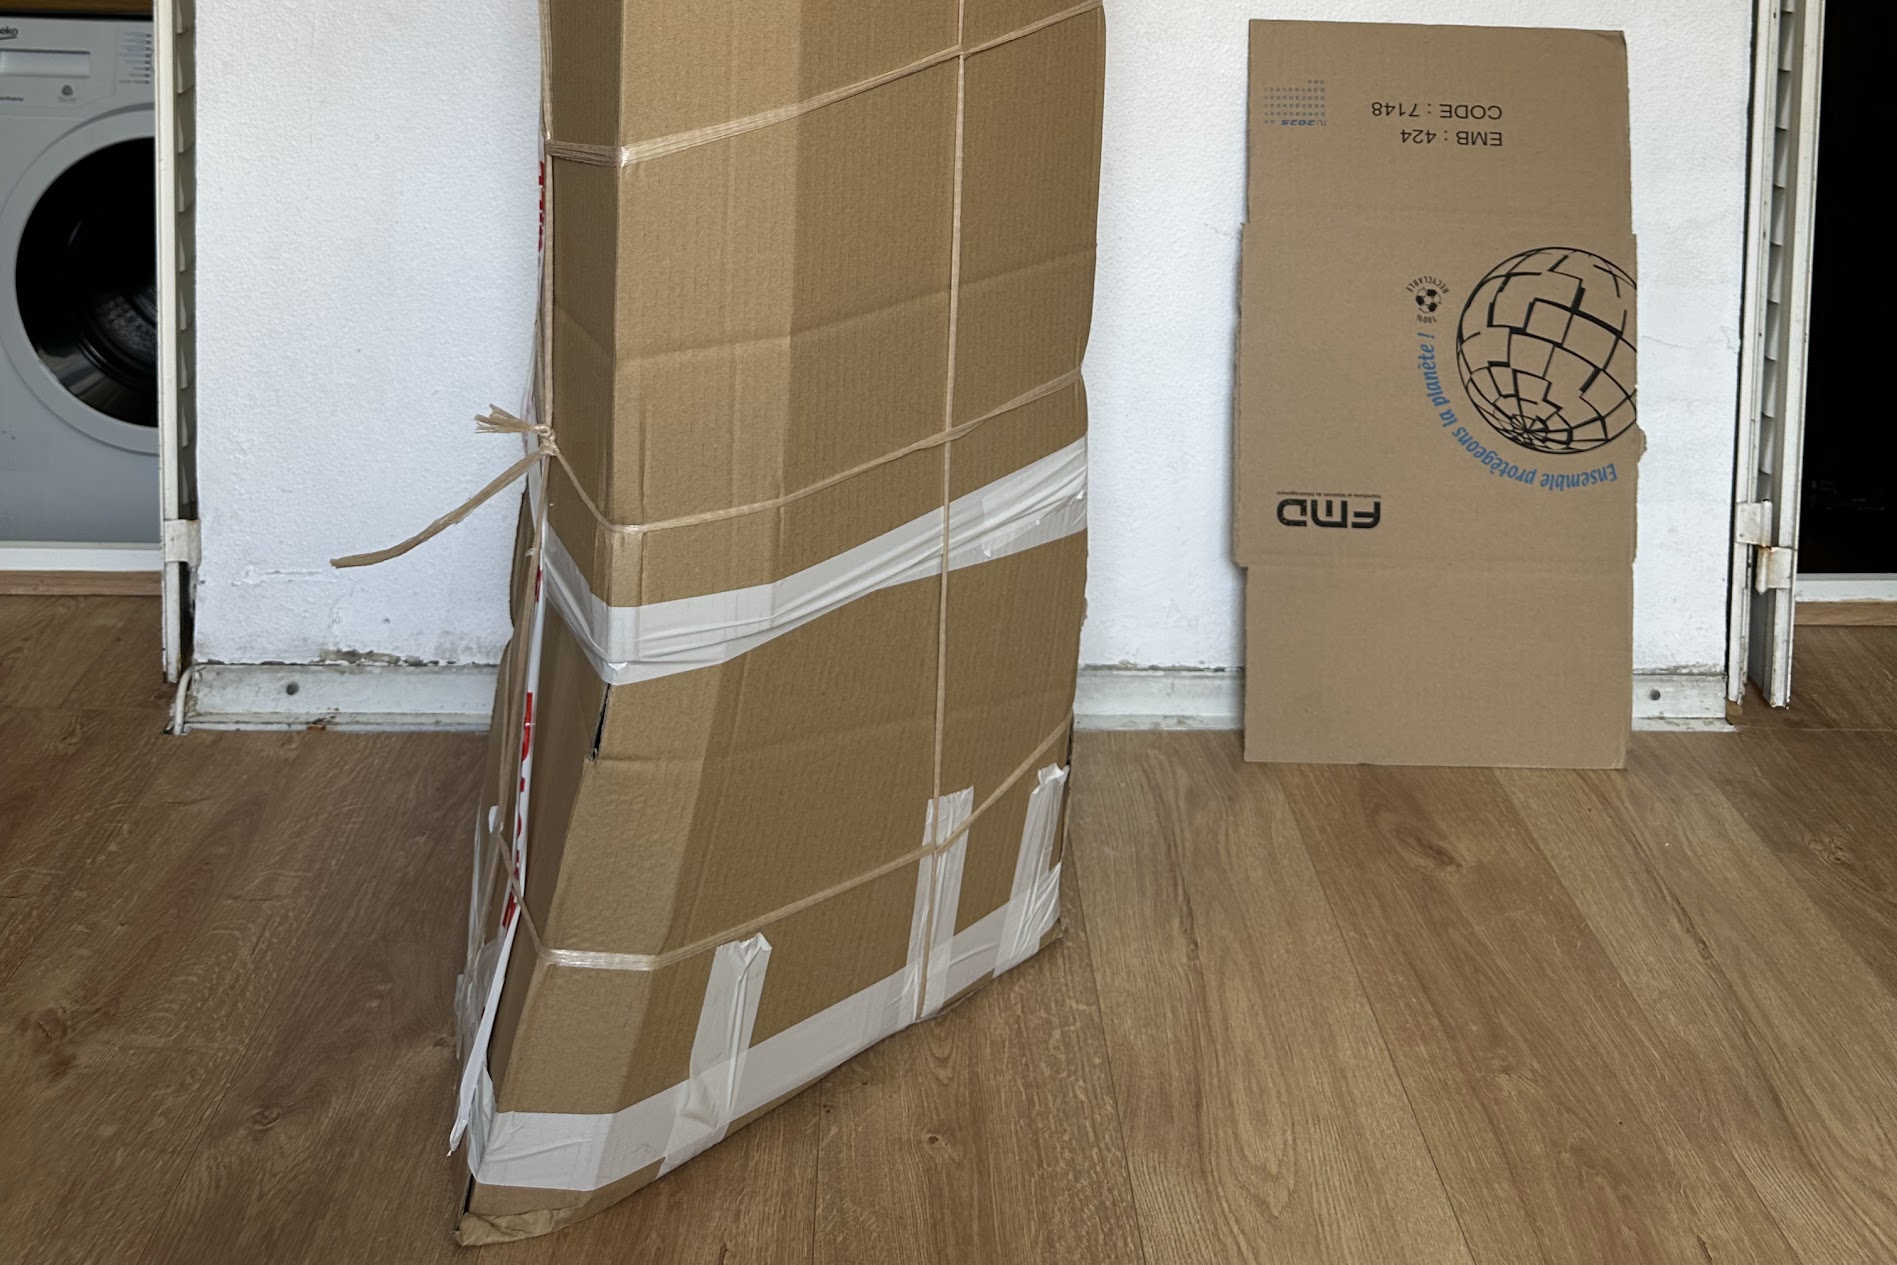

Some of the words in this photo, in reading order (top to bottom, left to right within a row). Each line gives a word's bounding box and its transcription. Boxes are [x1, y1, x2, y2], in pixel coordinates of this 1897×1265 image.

[1371, 101, 1420, 118] 7148
[1439, 103, 1503, 120] CODE
[1280, 119, 1316, 127] 2025
[1401, 129, 1437, 144] 424
[1456, 130, 1503, 147] EMB
[1405, 276, 1450, 294] RECYCLABLE
[1416, 314, 1437, 324] 100%
[1417, 343, 1450, 407] planète
[1439, 409, 1458, 428] la
[1540, 463, 1617, 491] Ensemble
[1276, 498, 1381, 529] FMD
